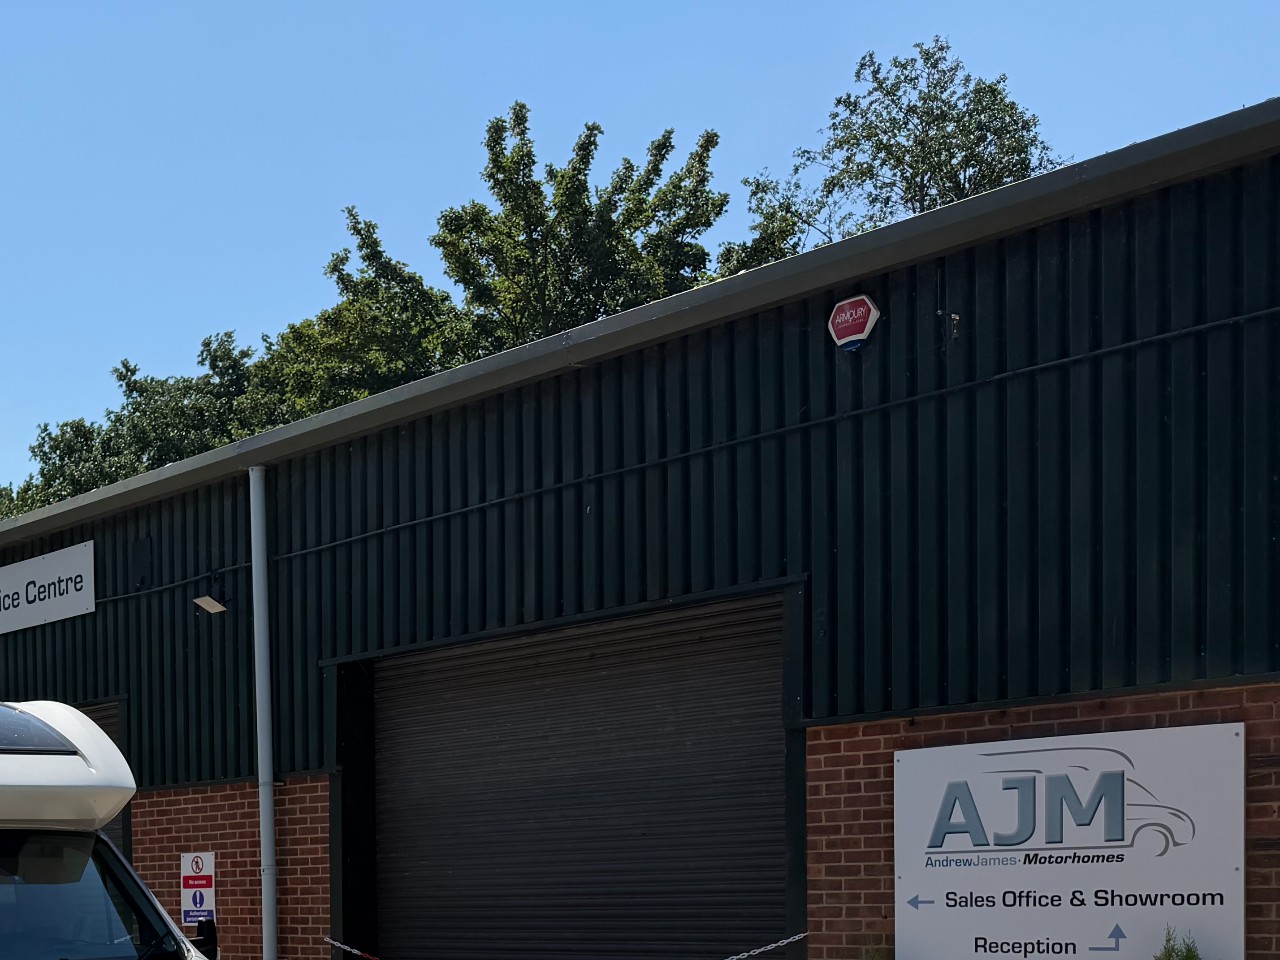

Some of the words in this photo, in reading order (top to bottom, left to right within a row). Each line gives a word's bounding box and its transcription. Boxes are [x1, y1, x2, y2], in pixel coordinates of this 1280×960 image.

[835, 306, 867, 323] ARMOURY
[25, 573, 84, 604] Centre
[926, 769, 1125, 849] AJM
[1023, 852, 1125, 865] Motorhomes
[945, 892, 996, 908] Sales
[1002, 890, 1062, 908] Office
[1069, 890, 1086, 907] &
[1094, 889, 1225, 907] Showroom
[974, 937, 1077, 959] Reception
